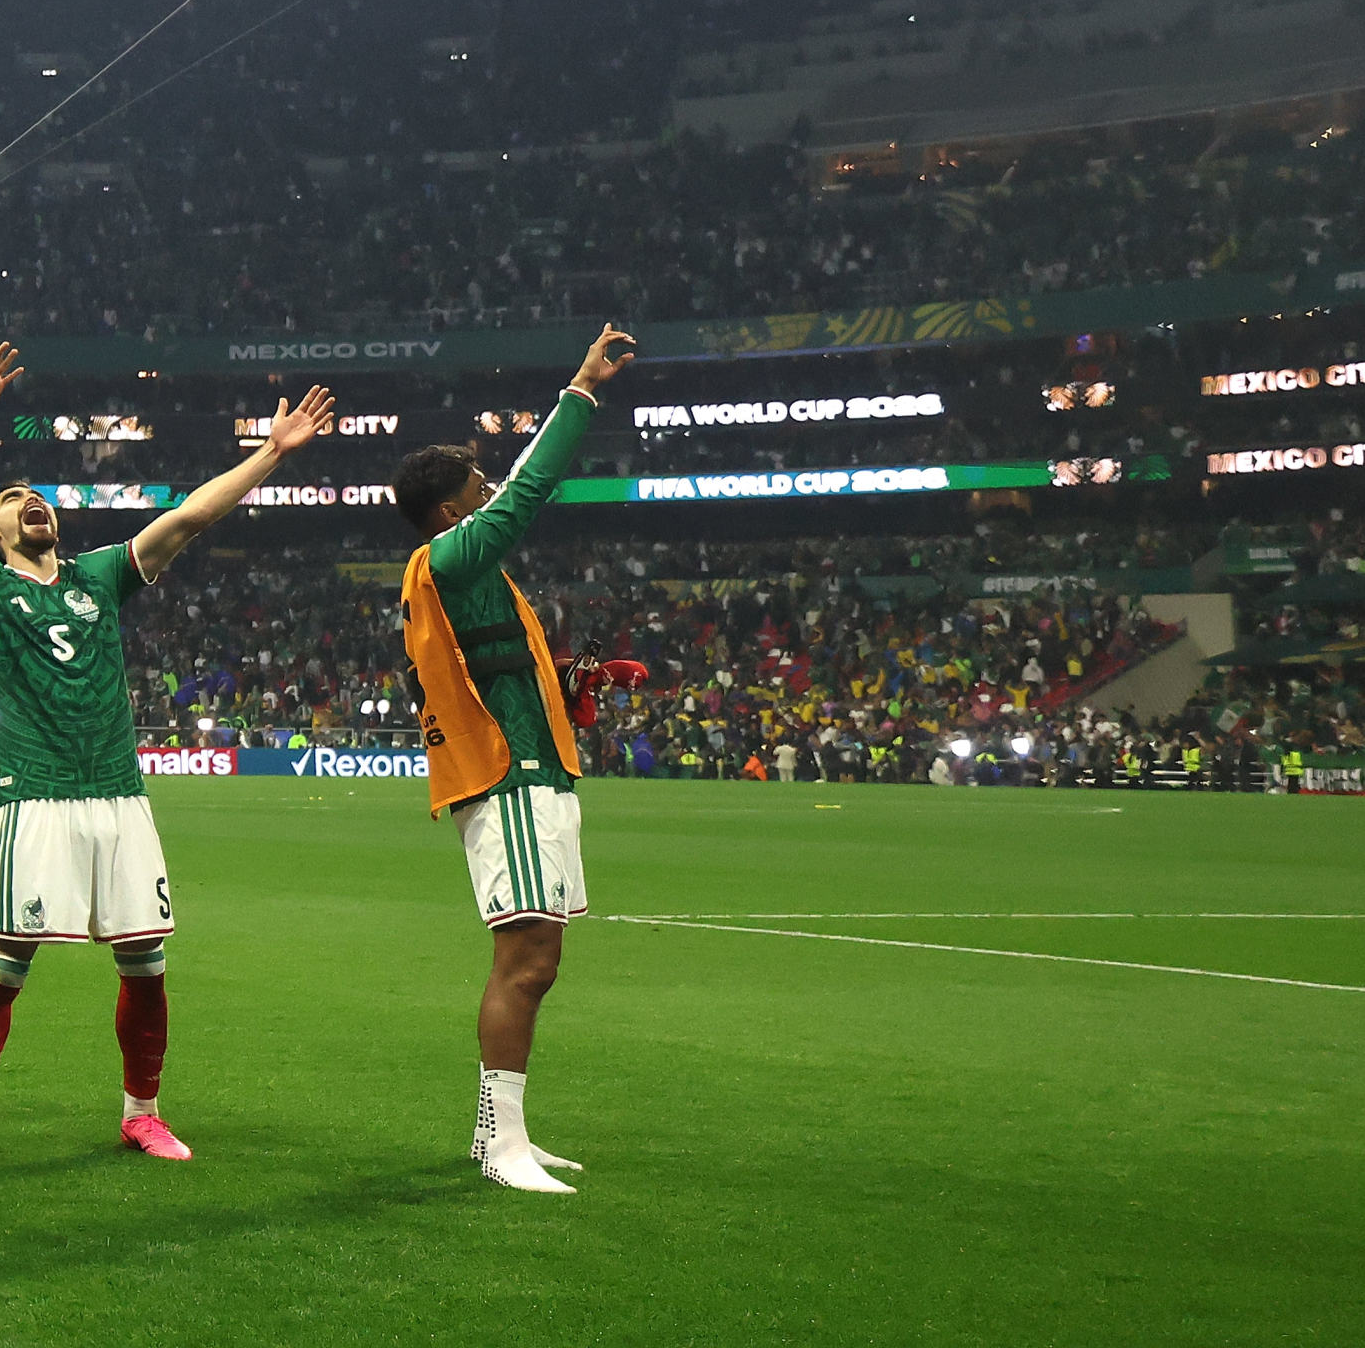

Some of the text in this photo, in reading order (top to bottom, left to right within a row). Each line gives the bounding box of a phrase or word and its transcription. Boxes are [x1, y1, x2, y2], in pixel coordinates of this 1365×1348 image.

[228, 341, 442, 360] MEXICO CITY
[1201, 367, 1320, 396] MEXICO
[634, 393, 944, 427] FIFA WORLD CUP 2026
[339, 415, 398, 435] CITY
[1207, 447, 1327, 475] MEXICO
[238, 486, 337, 506] MEXICO
[638, 466, 950, 499] FIFA WORLD CUP 2026
[48, 624, 75, 662] 5
[425, 728, 446, 749] 6
[315, 749, 429, 777] Rexona
[156, 877, 171, 920] 5
